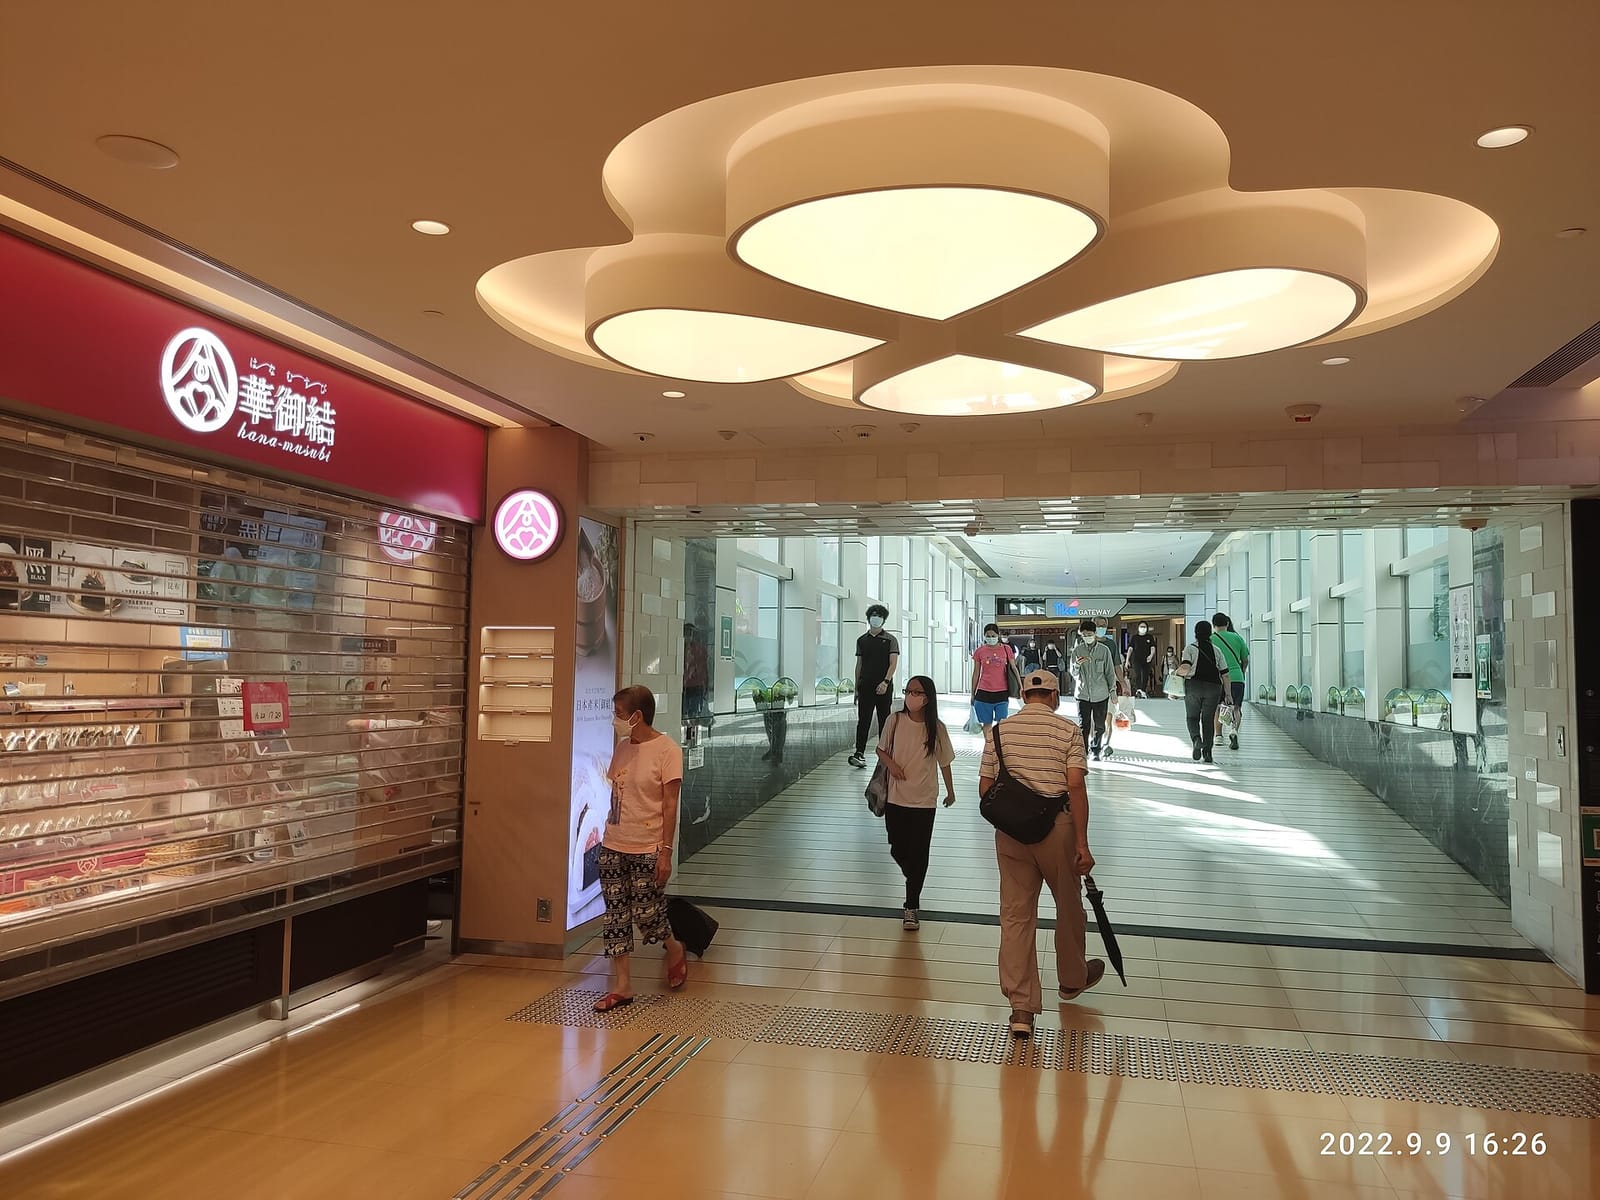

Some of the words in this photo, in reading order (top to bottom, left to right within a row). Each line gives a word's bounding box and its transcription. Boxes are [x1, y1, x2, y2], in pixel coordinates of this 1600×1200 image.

[238, 374, 336, 446] 華御結
[237, 421, 331, 462] hana-musubi
[30, 574, 47, 582] BLACK
[1078, 608, 1112, 616] GATEWAY
